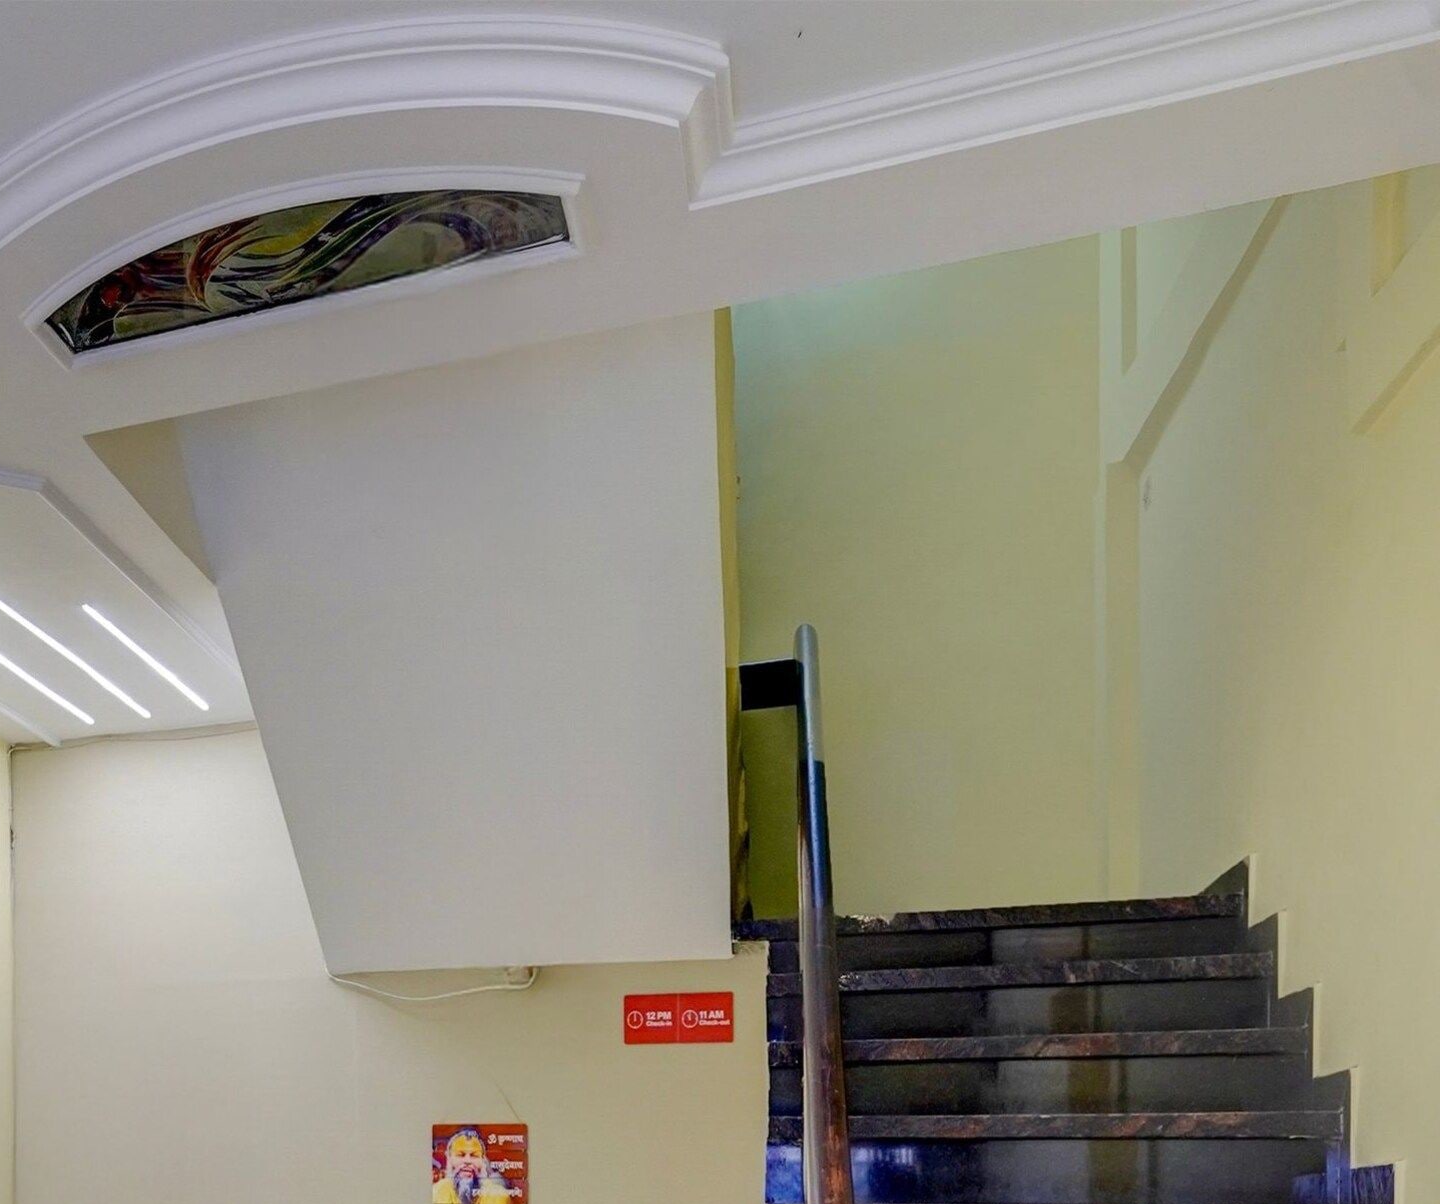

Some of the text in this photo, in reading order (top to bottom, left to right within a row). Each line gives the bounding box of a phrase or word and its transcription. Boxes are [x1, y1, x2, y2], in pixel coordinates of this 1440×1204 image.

[646, 1011, 672, 1020] 12 PM
[699, 1010, 725, 1019] 11 AM
